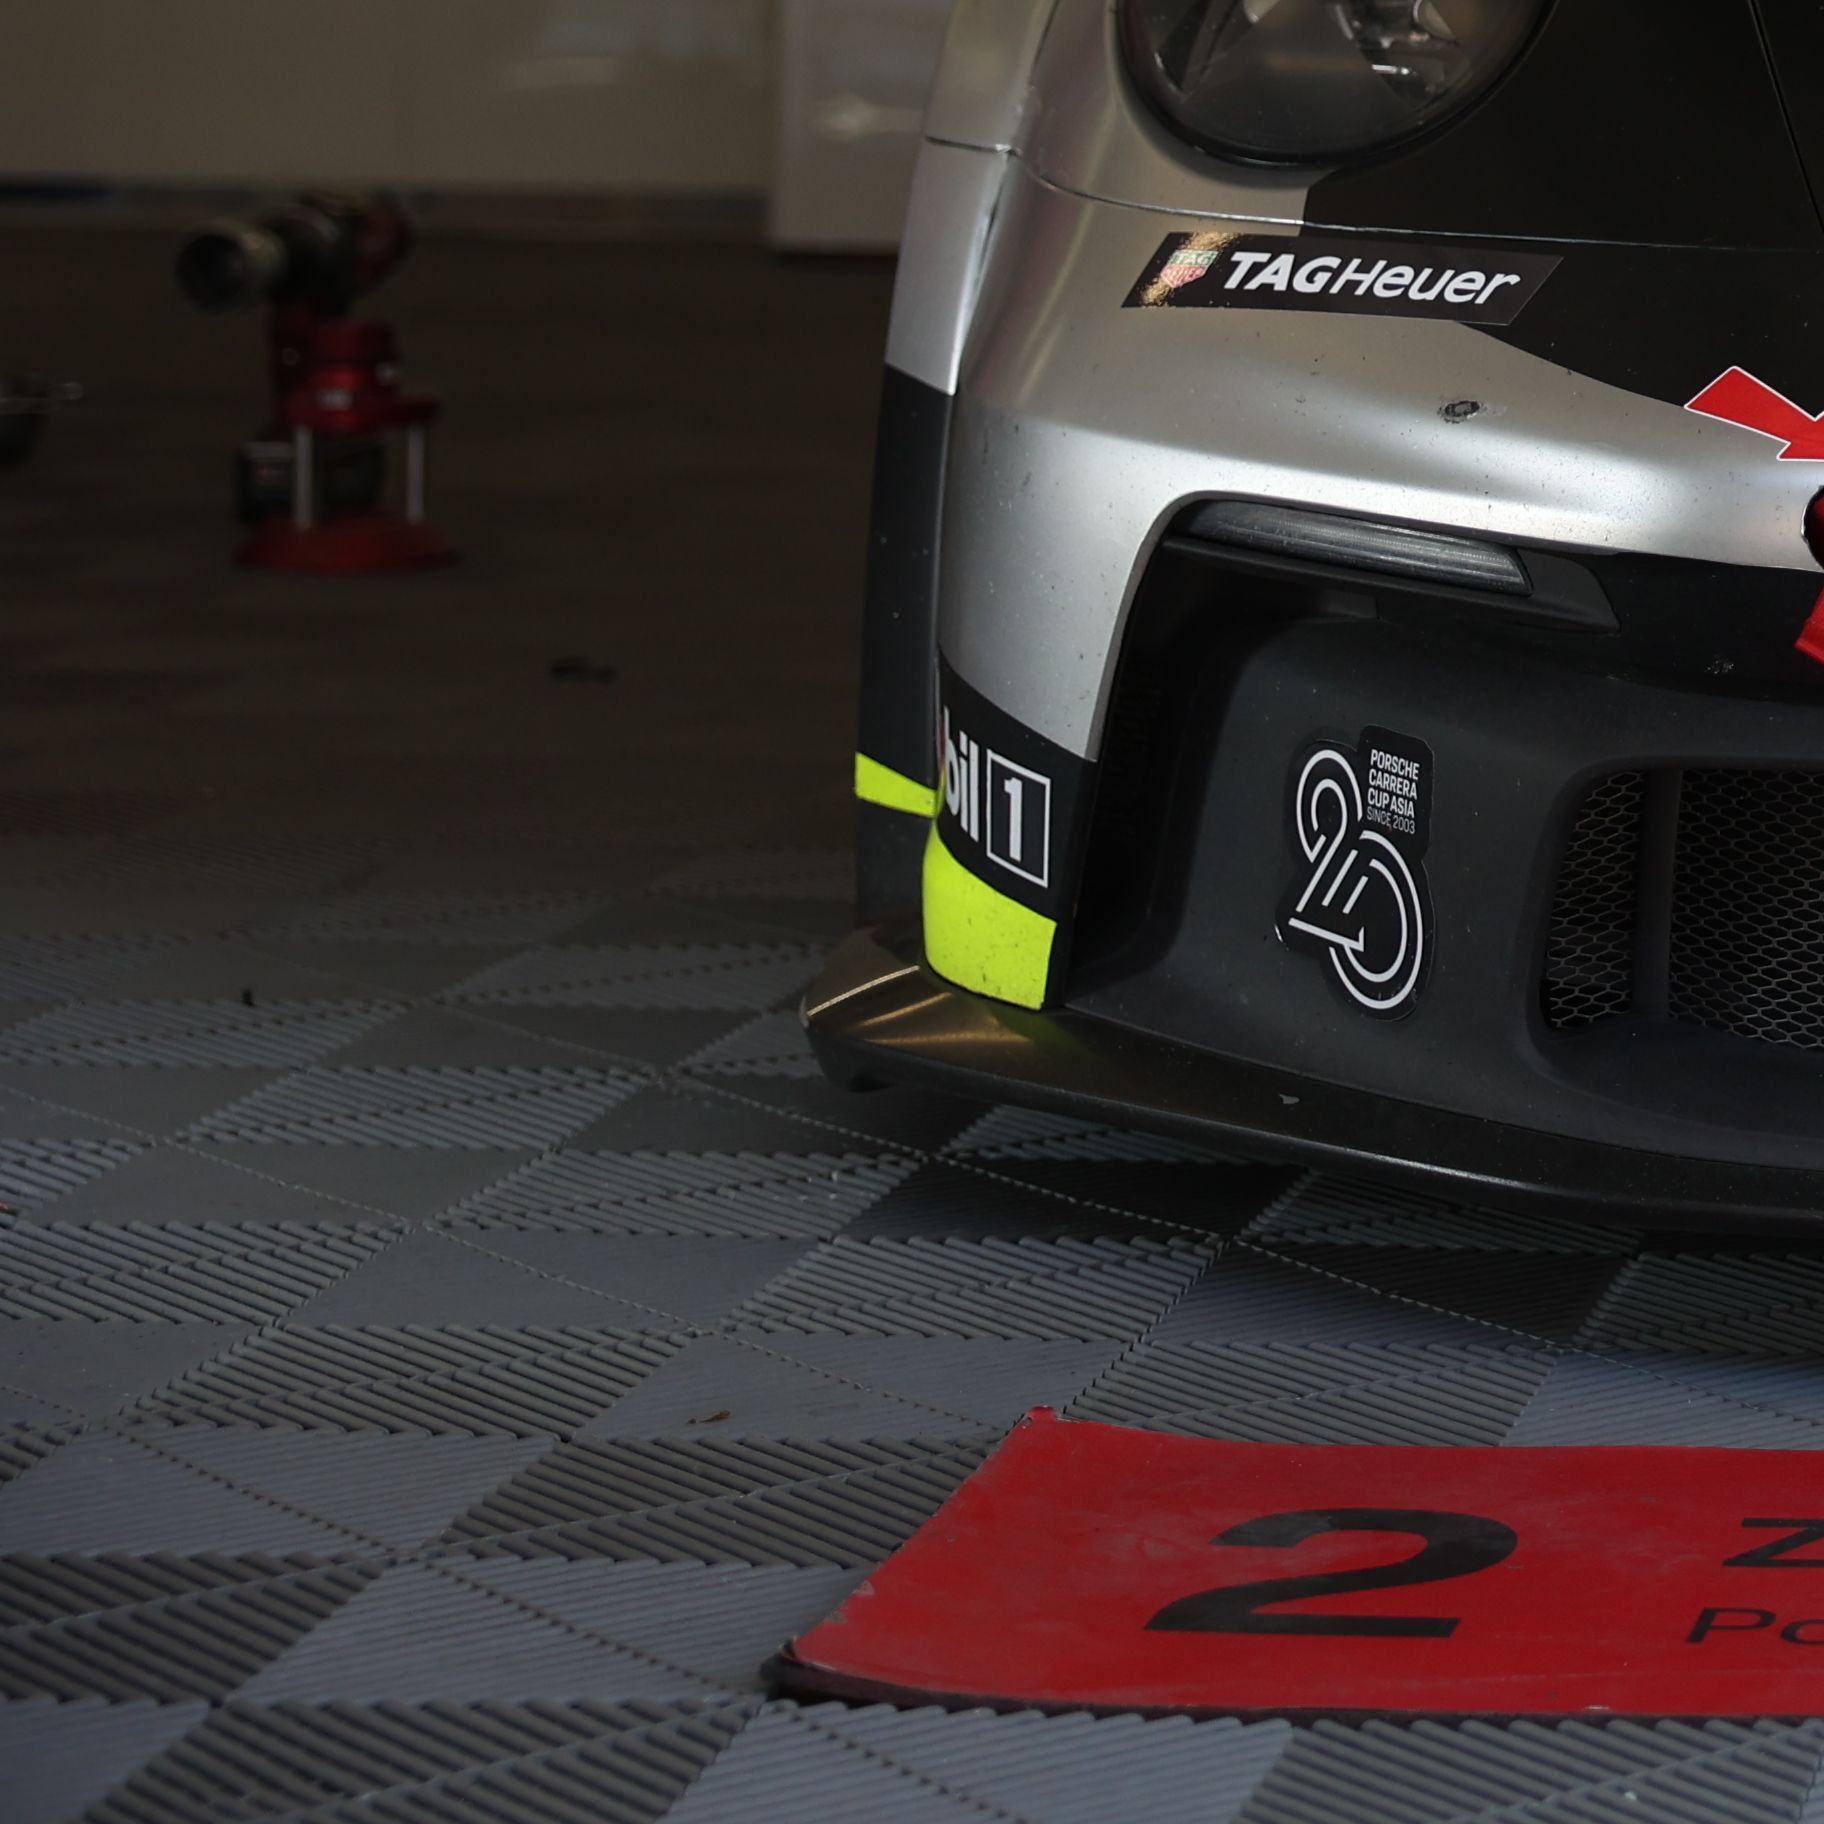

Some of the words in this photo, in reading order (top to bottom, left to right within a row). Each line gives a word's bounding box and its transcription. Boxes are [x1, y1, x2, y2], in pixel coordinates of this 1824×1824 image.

[1370, 748, 1420, 781] PORSCHE
[1368, 768, 1418, 800] CARRERA
[1367, 787, 1390, 809] CUP
[1390, 795, 1415, 818] ASIA
[1004, 776, 1023, 862] 1
[1366, 805, 1392, 827] SINCE
[1392, 814, 1416, 835] 2003
[1142, 1506, 1520, 1642] 2
